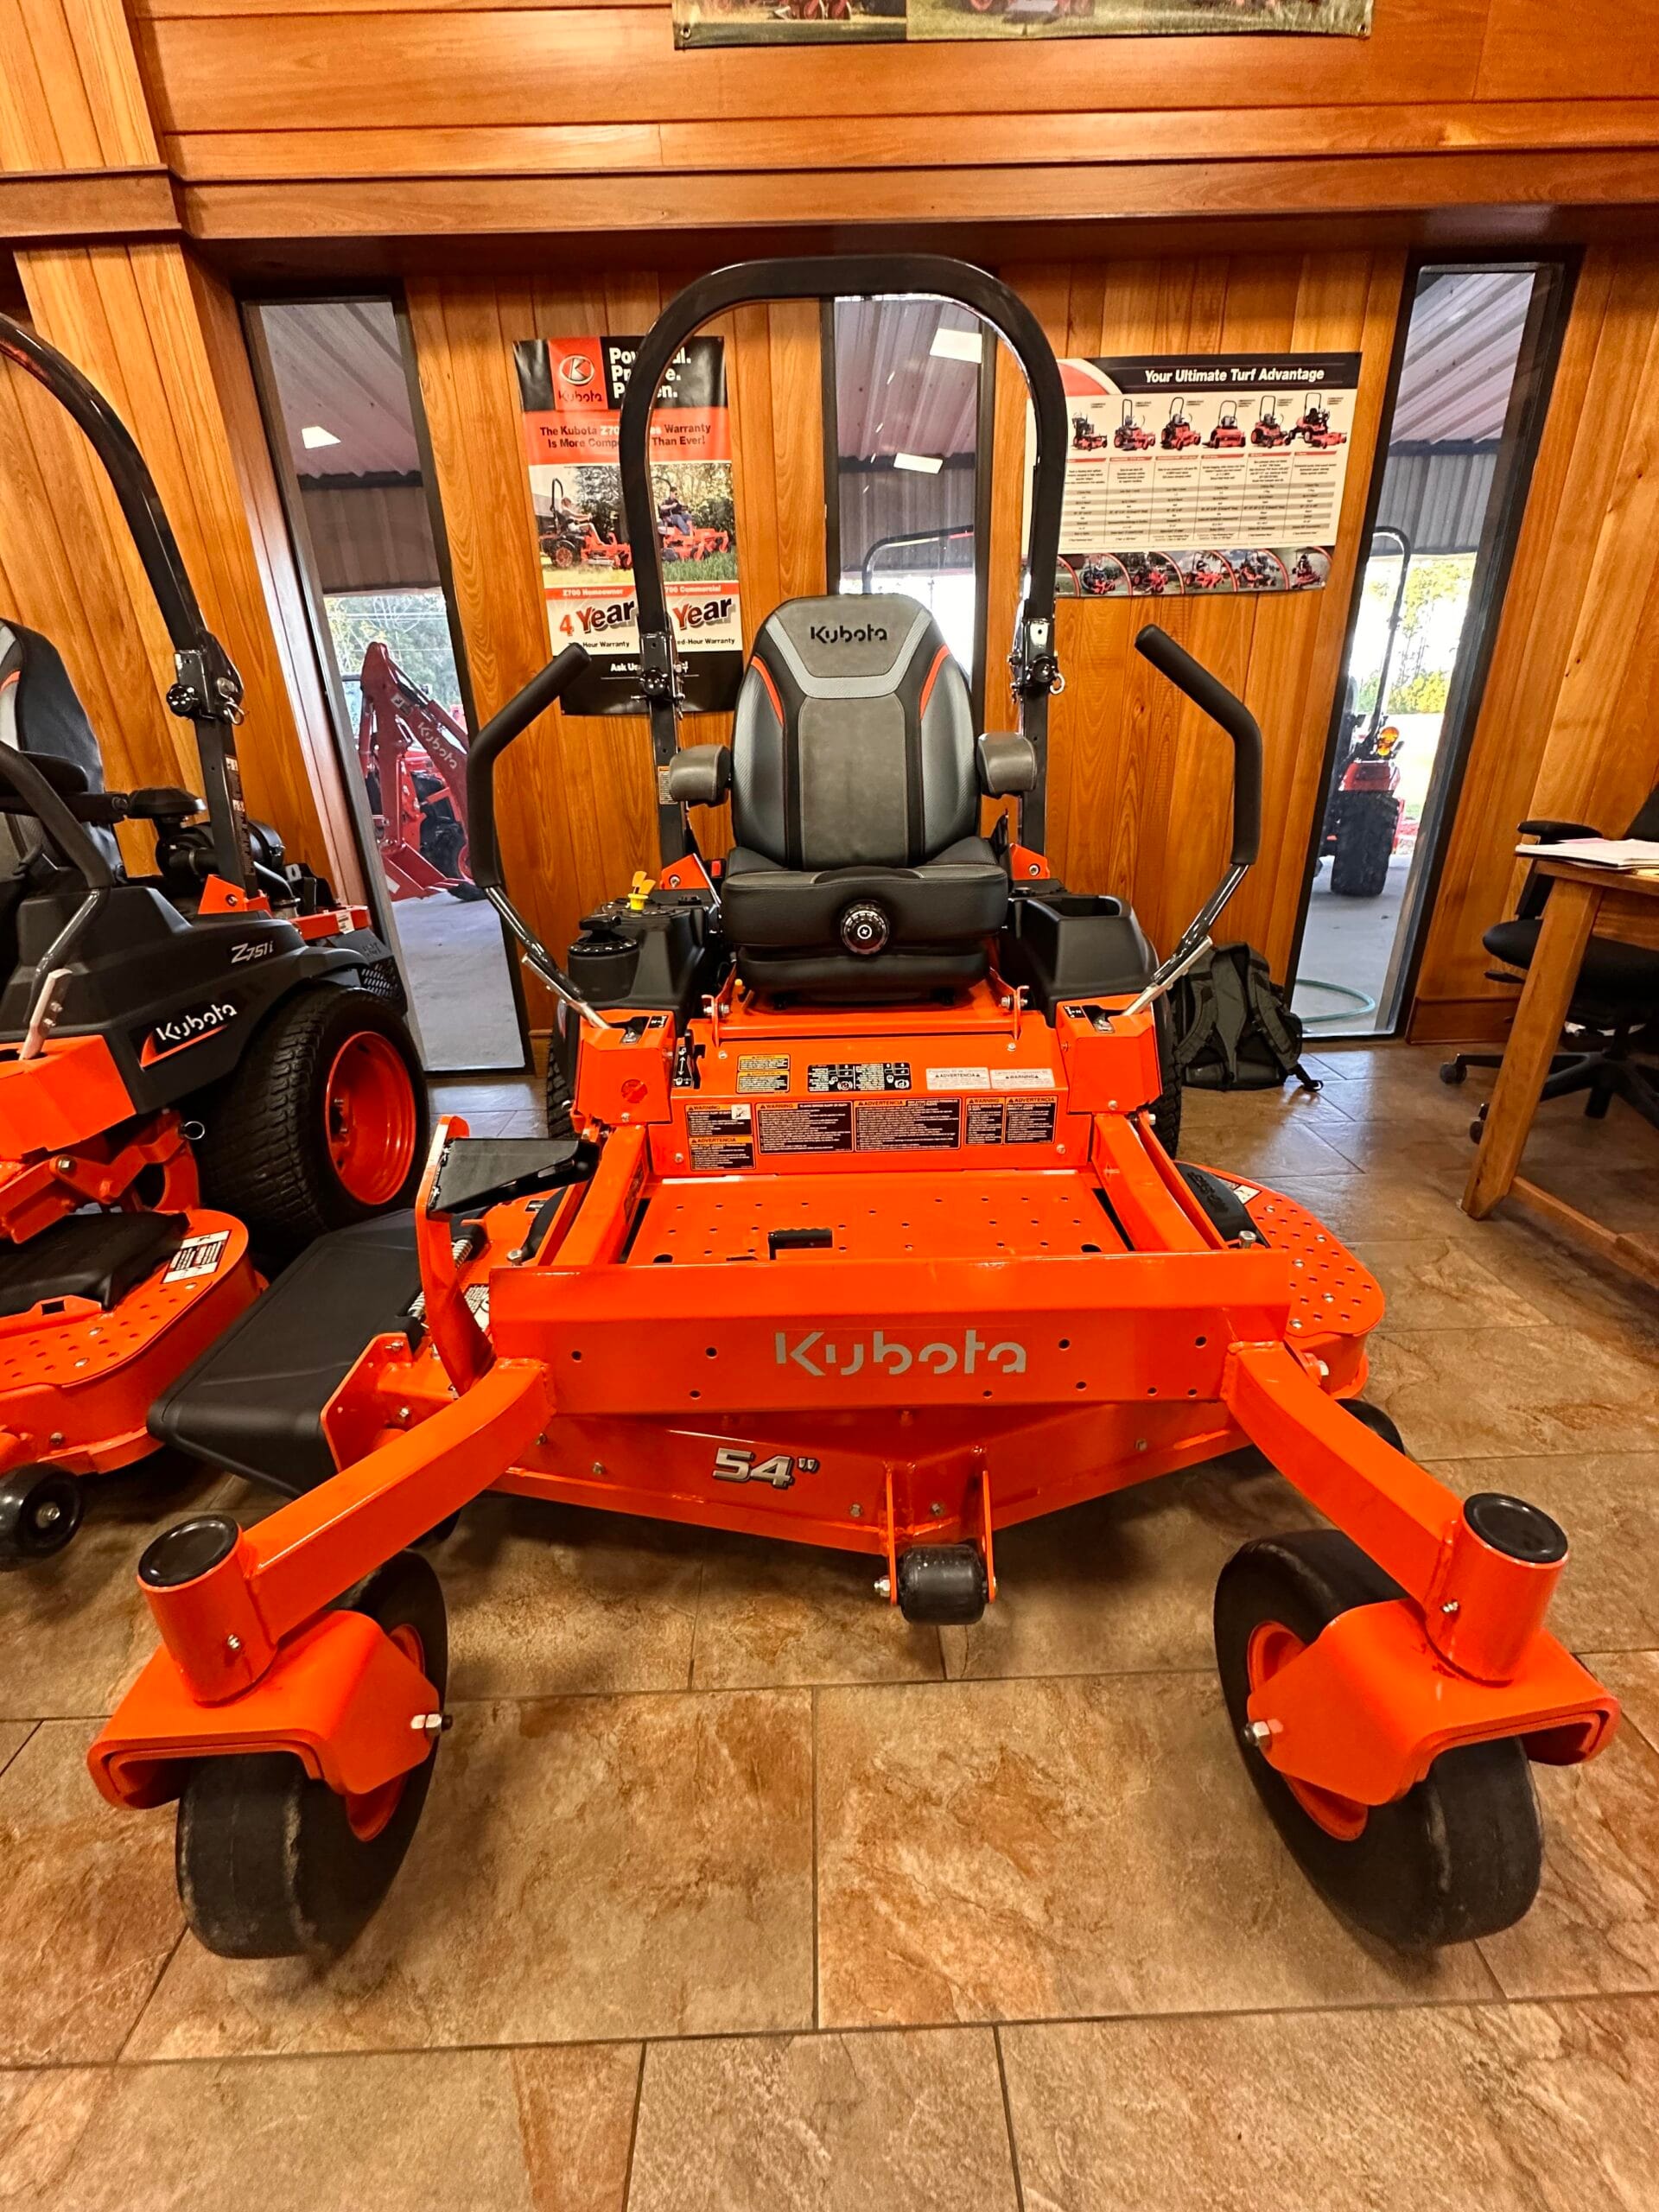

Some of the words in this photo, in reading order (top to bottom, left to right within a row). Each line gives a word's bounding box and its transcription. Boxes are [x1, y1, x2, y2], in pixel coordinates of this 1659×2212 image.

[1145, 370, 1173, 384] Your
[1175, 368, 1227, 383] Ultimate
[1230, 368, 1256, 382] Turf
[1258, 367, 1325, 383] Advantage
[558, 390, 603, 404] Kubota
[539, 426, 559, 436] The
[560, 426, 597, 435] Kubota
[664, 423, 711, 435] Warranty
[547, 438, 557, 448] Is
[559, 438, 586, 448] More
[652, 436, 677, 447] Than
[679, 435, 706, 446] Ever!
[559, 614, 575, 637] 4
[575, 600, 637, 634] Year
[672, 597, 734, 631] Year
[810, 624, 887, 644] Kubota
[610, 663, 627, 672] Ask
[417, 721, 458, 769] Kubota
[231, 940, 275, 963] Z751i
[156, 1004, 238, 1041] Kubota
[774, 1329, 1027, 1376] Kubota
[712, 1447, 820, 1490] 54"
